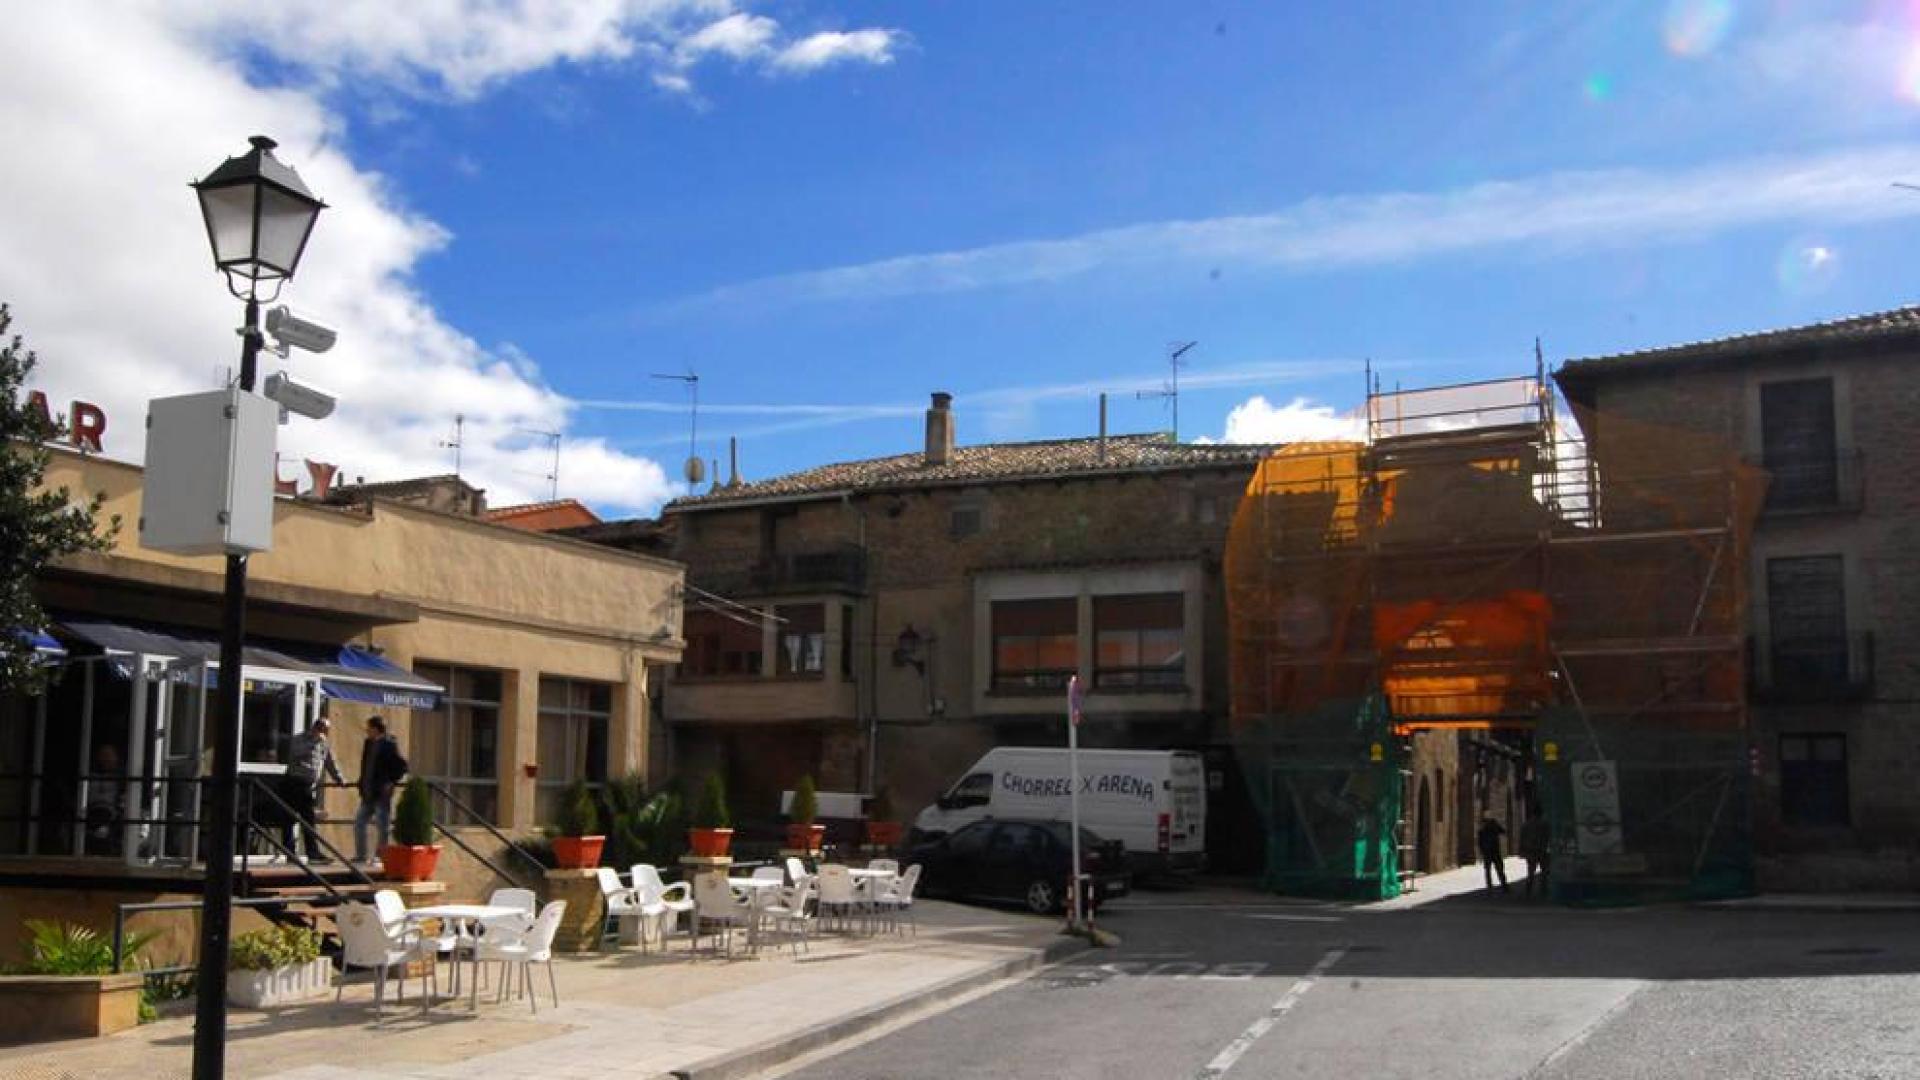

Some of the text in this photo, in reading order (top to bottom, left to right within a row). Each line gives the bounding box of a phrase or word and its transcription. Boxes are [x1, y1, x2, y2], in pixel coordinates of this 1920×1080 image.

[26, 390, 339, 497] AR LY
[1080, 775, 1094, 793] X
[1097, 775, 1154, 802] ARENA
